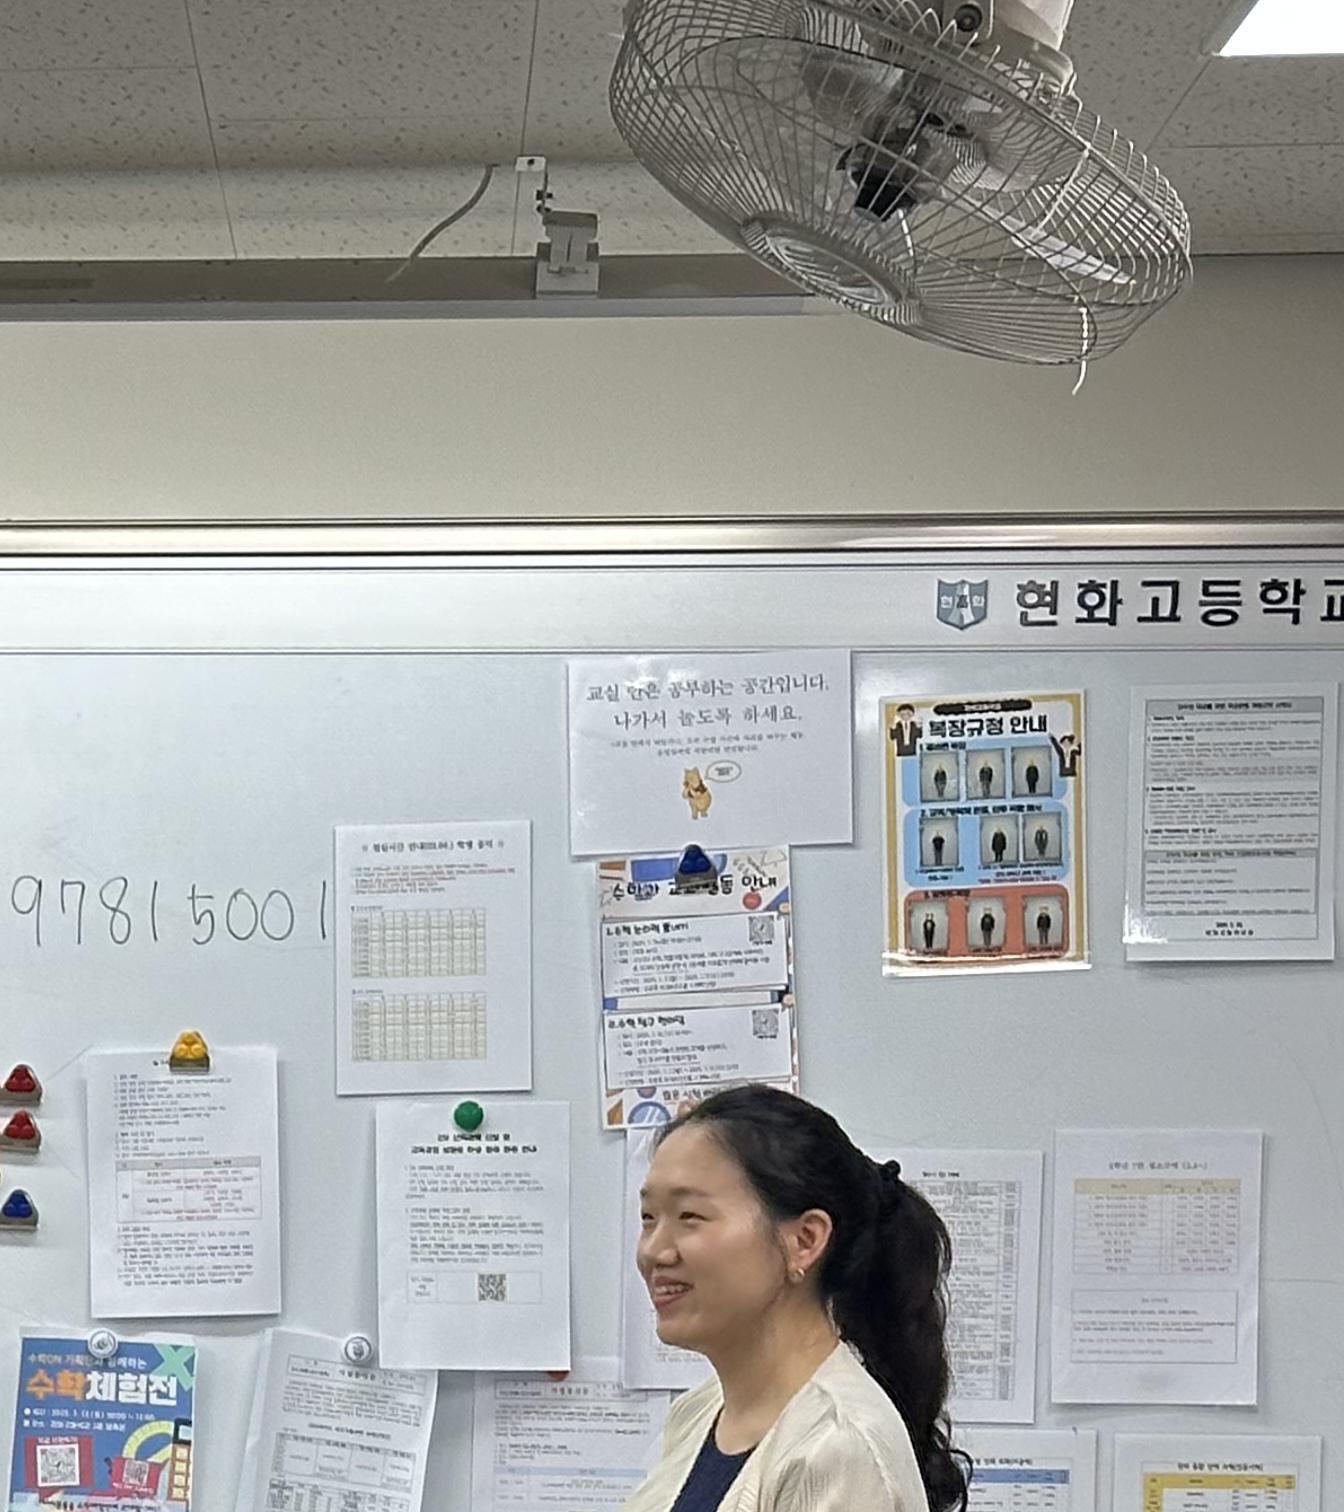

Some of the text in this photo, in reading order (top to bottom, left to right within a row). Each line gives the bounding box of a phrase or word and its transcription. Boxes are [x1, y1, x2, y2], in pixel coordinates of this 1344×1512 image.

[587, 683, 620, 702] 교실
[668, 679, 733, 698] 공부하는
[742, 674, 829, 694] 공간입니다.
[614, 709, 667, 730] 나가서
[743, 704, 802, 723] 하세요.
[928, 714, 1047, 738] 복장규정 안내
[741, 876, 777, 892] 안내
[26, 1368, 178, 1406] 수학체험전
